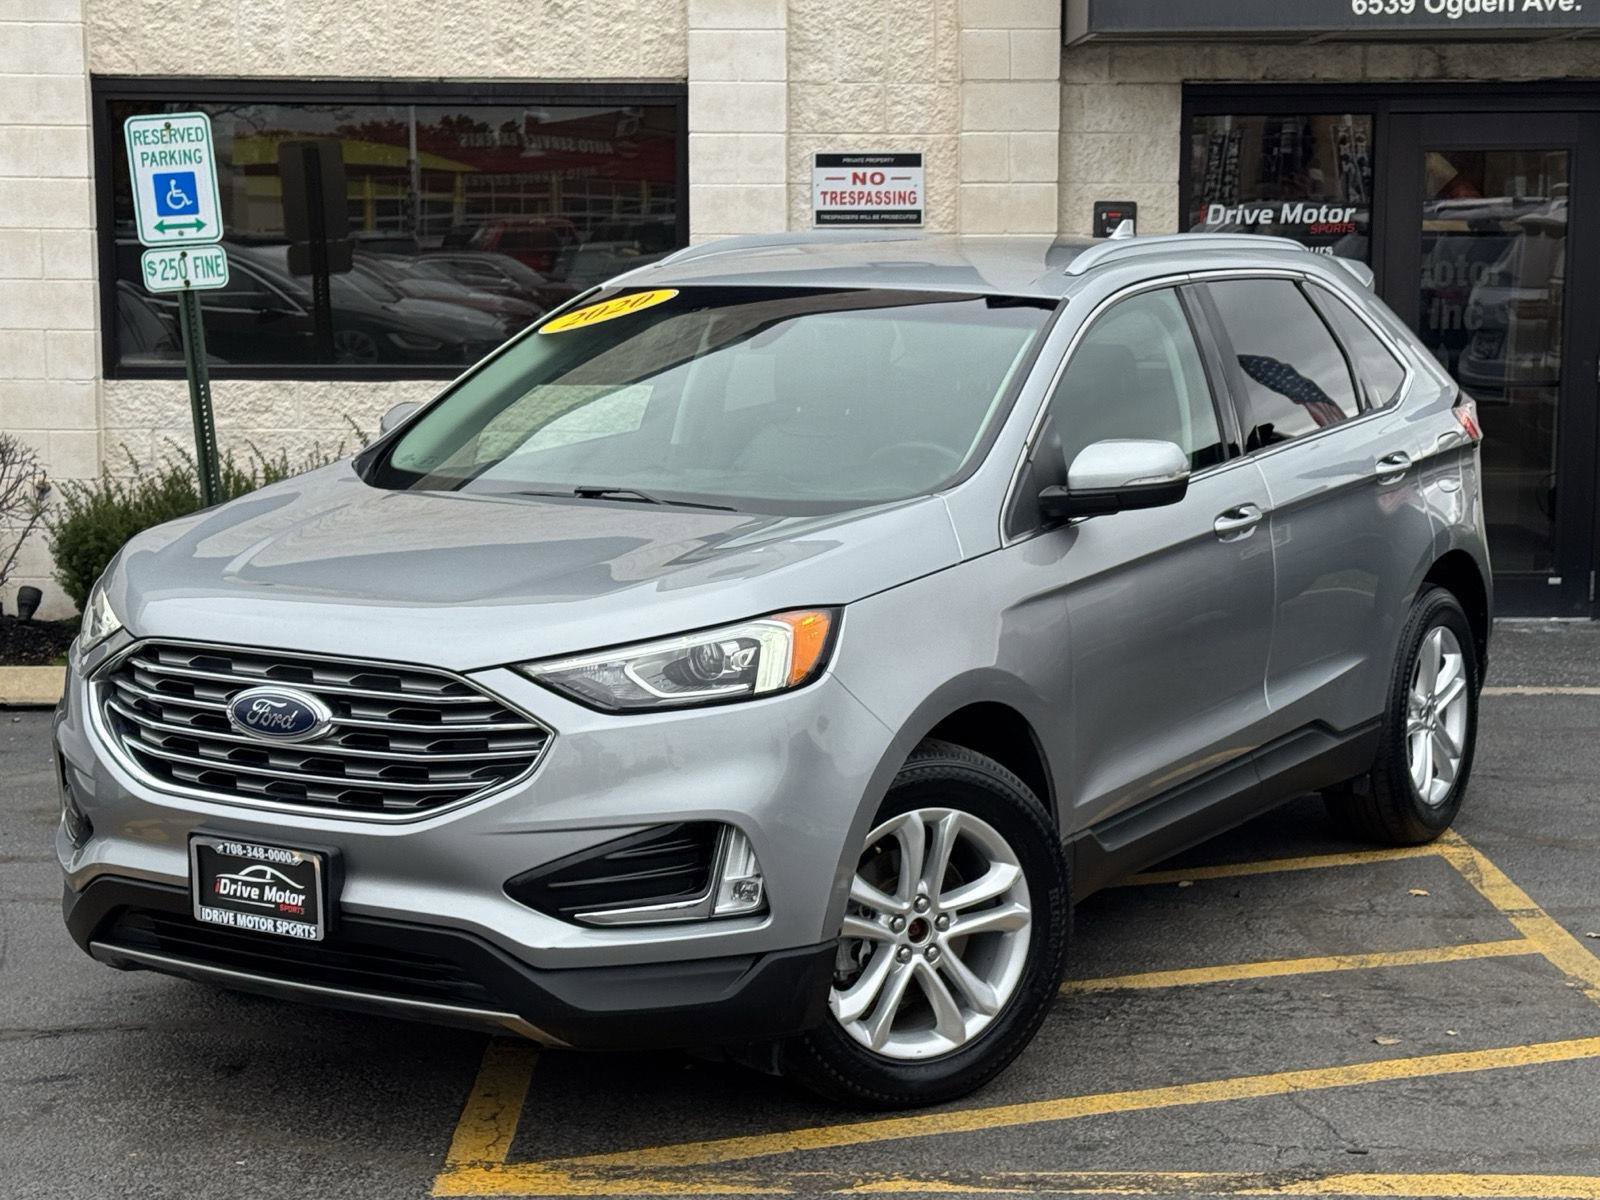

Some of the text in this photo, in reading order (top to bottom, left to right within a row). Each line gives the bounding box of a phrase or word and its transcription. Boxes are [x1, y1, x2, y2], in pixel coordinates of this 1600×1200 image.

[1351, 0, 1582, 19] 6539 Ogden Ave.
[132, 126, 205, 146] RESERVED
[140, 148, 203, 167] PARKING
[851, 171, 885, 186] NO
[820, 190, 918, 206] TRESPASSING
[1280, 202, 1356, 224] Motor
[1309, 223, 1356, 235] SPORTS
[147, 255, 225, 282] $250 FINE
[558, 293, 655, 329] 2020
[246, 698, 298, 730] Ford
[224, 842, 292, 863] 708-348-0000
[214, 878, 306, 907] iDrive Motor
[279, 904, 305, 915] SPORTS
[236, 913, 274, 932] MOTOR
[276, 921, 317, 939] SPORTS
